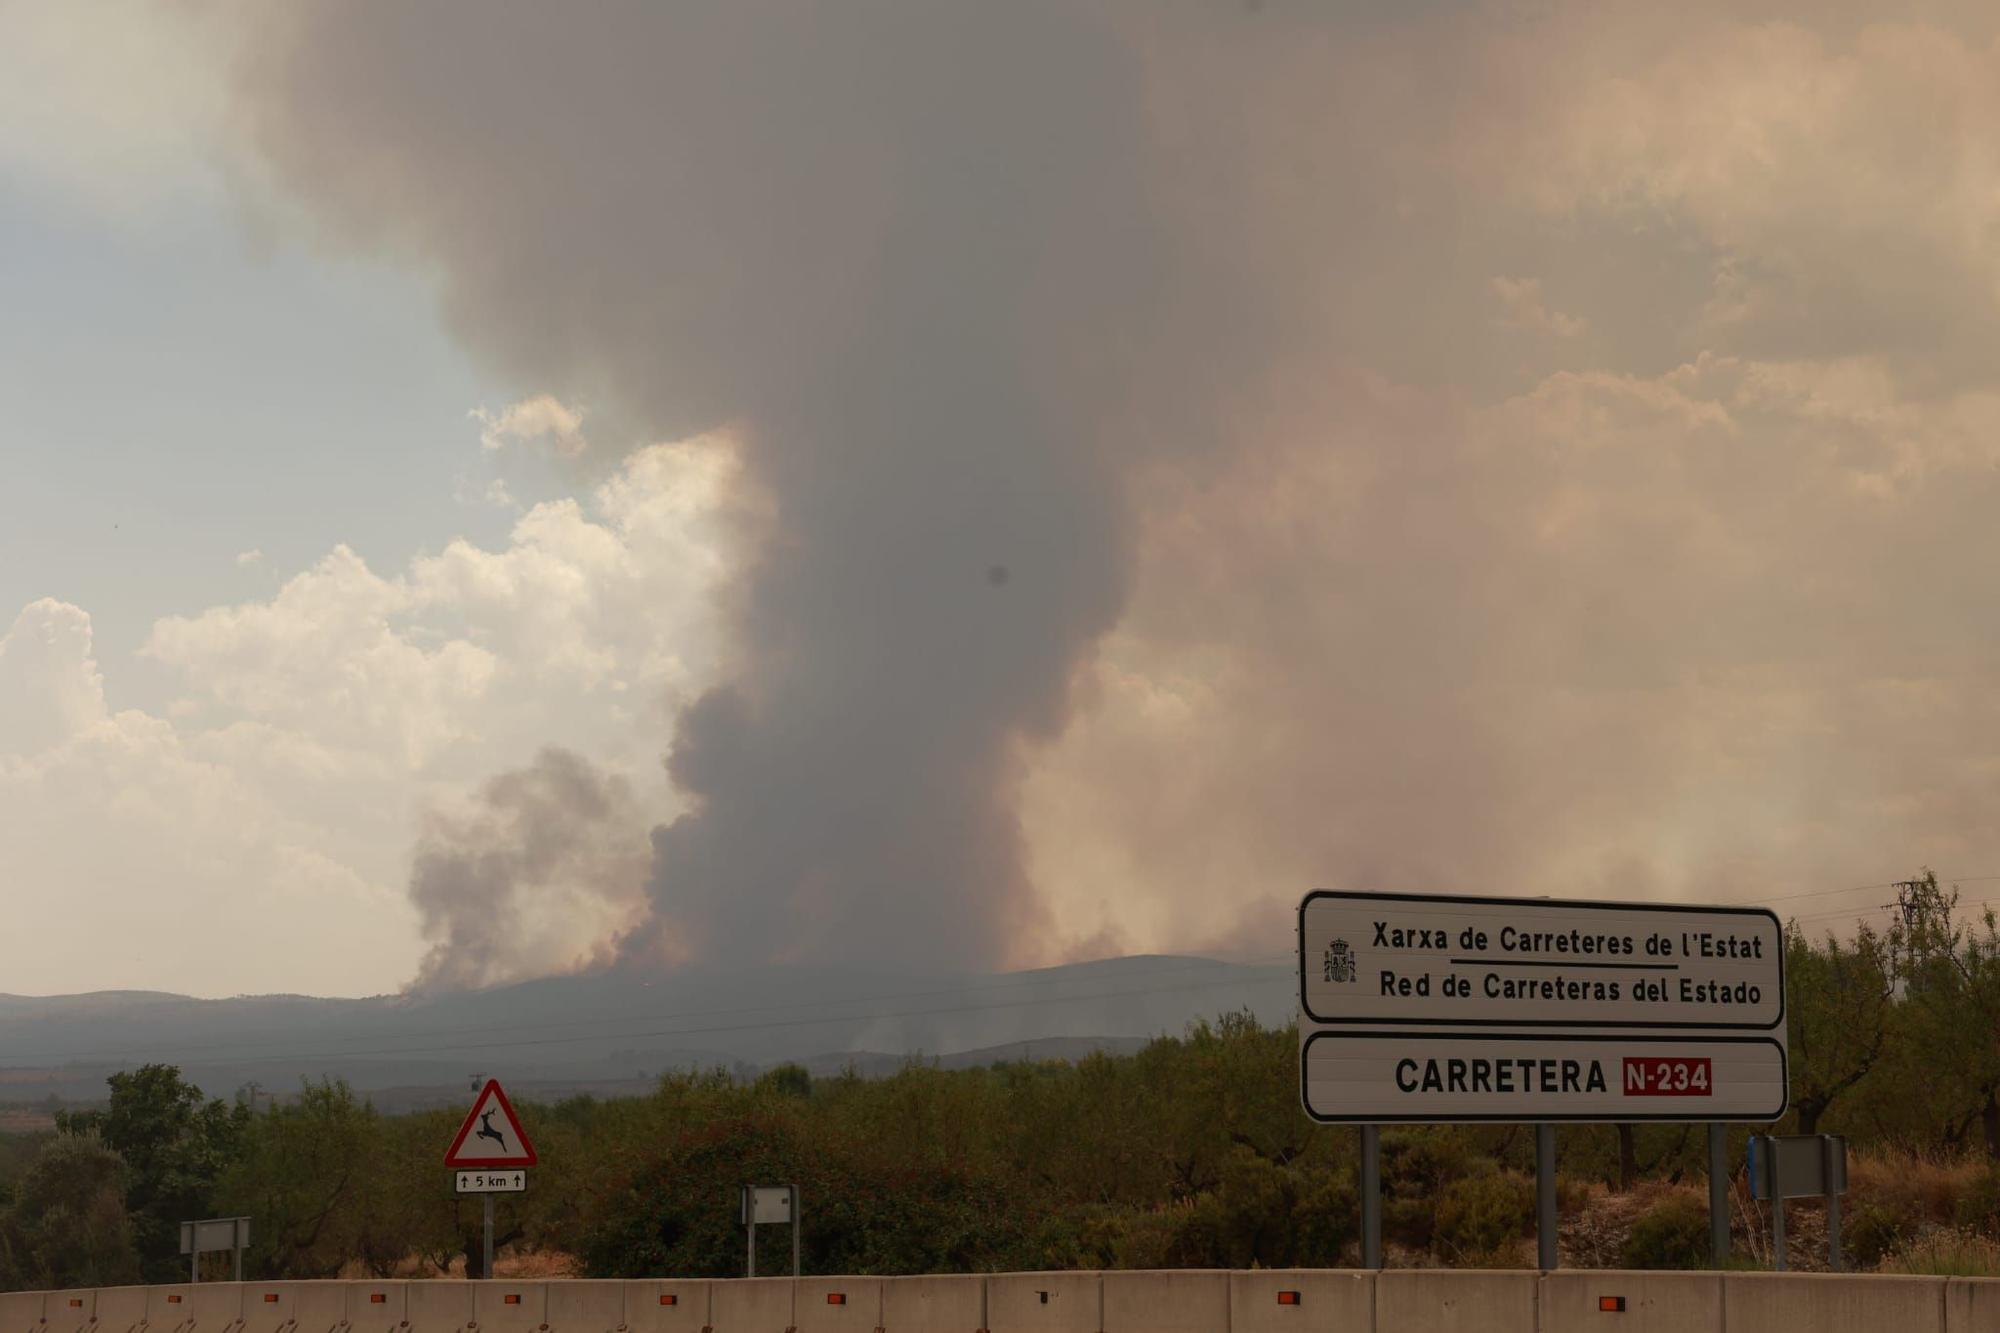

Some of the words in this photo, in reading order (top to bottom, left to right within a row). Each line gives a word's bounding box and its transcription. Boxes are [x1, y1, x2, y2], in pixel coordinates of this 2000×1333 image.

[1373, 922, 1447, 949] Xarxa
[1460, 927, 1487, 950] de
[1501, 927, 1633, 954] Carreteres
[1646, 934, 1672, 956] de
[1683, 933, 1761, 958] l'Estat
[1381, 971, 1429, 996] Red
[1443, 974, 1470, 997] de
[1484, 973, 1619, 1000] Carreteras
[1633, 978, 1668, 1001] del
[1680, 979, 1760, 1004] Estado
[1396, 1059, 1606, 1092] CARRETERA
[1627, 1063, 1708, 1091] N-234
[475, 1176, 484, 1187] 5
[488, 1176, 507, 1187] km
